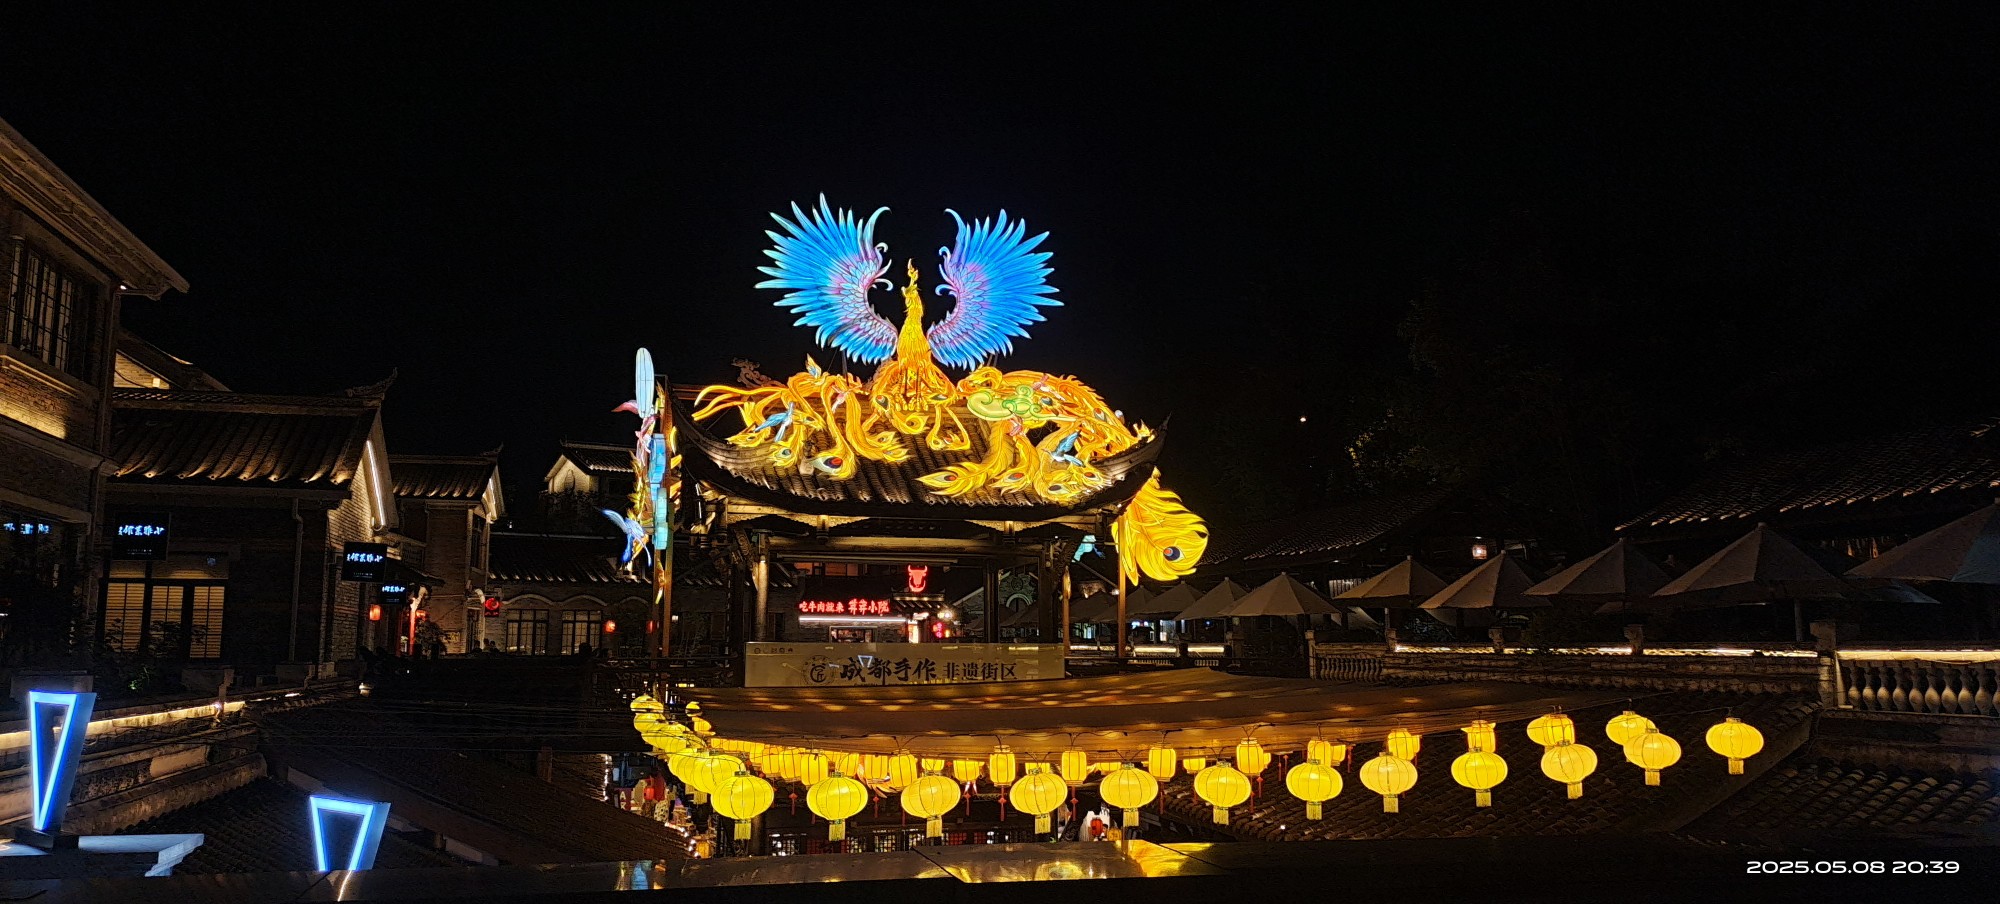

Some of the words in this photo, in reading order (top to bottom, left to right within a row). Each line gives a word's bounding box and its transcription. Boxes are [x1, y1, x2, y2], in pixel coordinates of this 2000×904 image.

[840, 656, 937, 685] 成都手作
[943, 662, 1018, 681] 非遗街区
